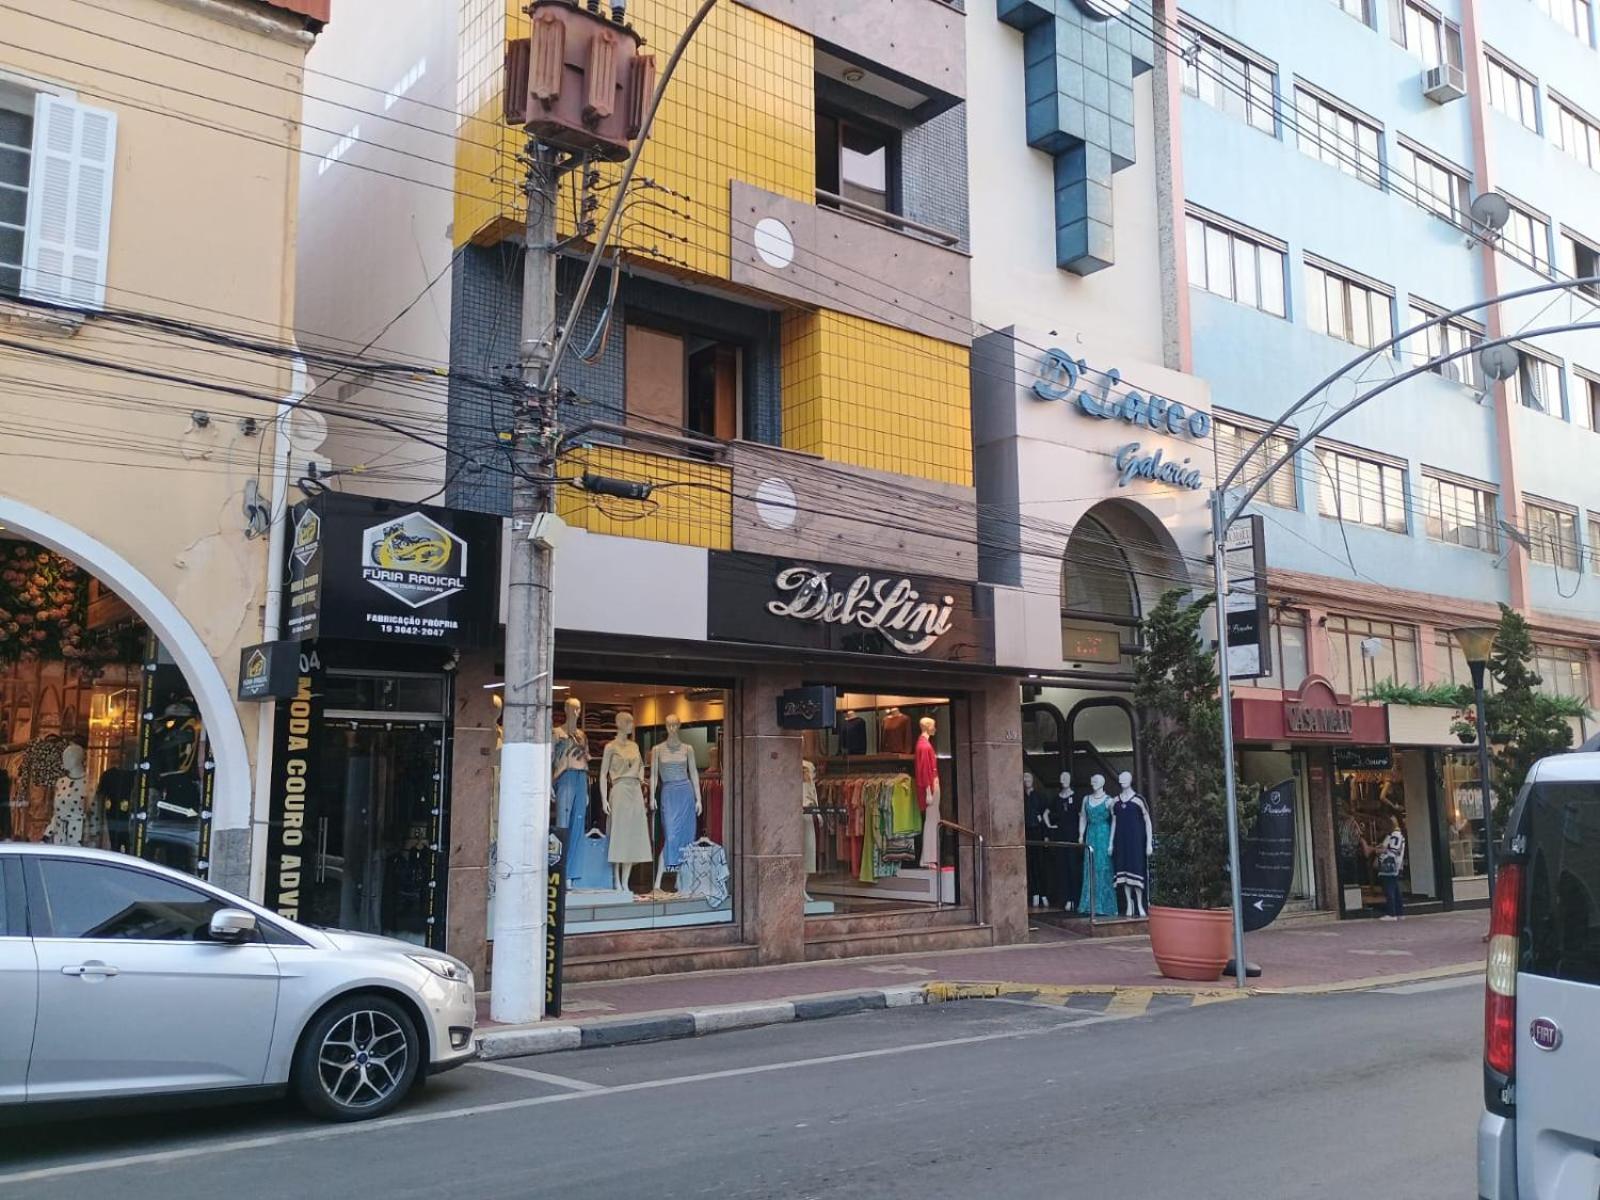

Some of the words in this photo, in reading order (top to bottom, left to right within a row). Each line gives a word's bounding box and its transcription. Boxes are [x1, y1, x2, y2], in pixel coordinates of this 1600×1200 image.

[1116, 442, 1201, 489] Galeria
[363, 567, 403, 582] FÚRIA
[408, 574, 464, 588] RADICAL
[366, 612, 420, 628] FABRICAÇÃO
[422, 617, 459, 629] PRÓPRIA
[287, 676, 312, 751] MODA
[280, 759, 307, 847] COURO
[1536, 1025, 1554, 1044] FIAT
